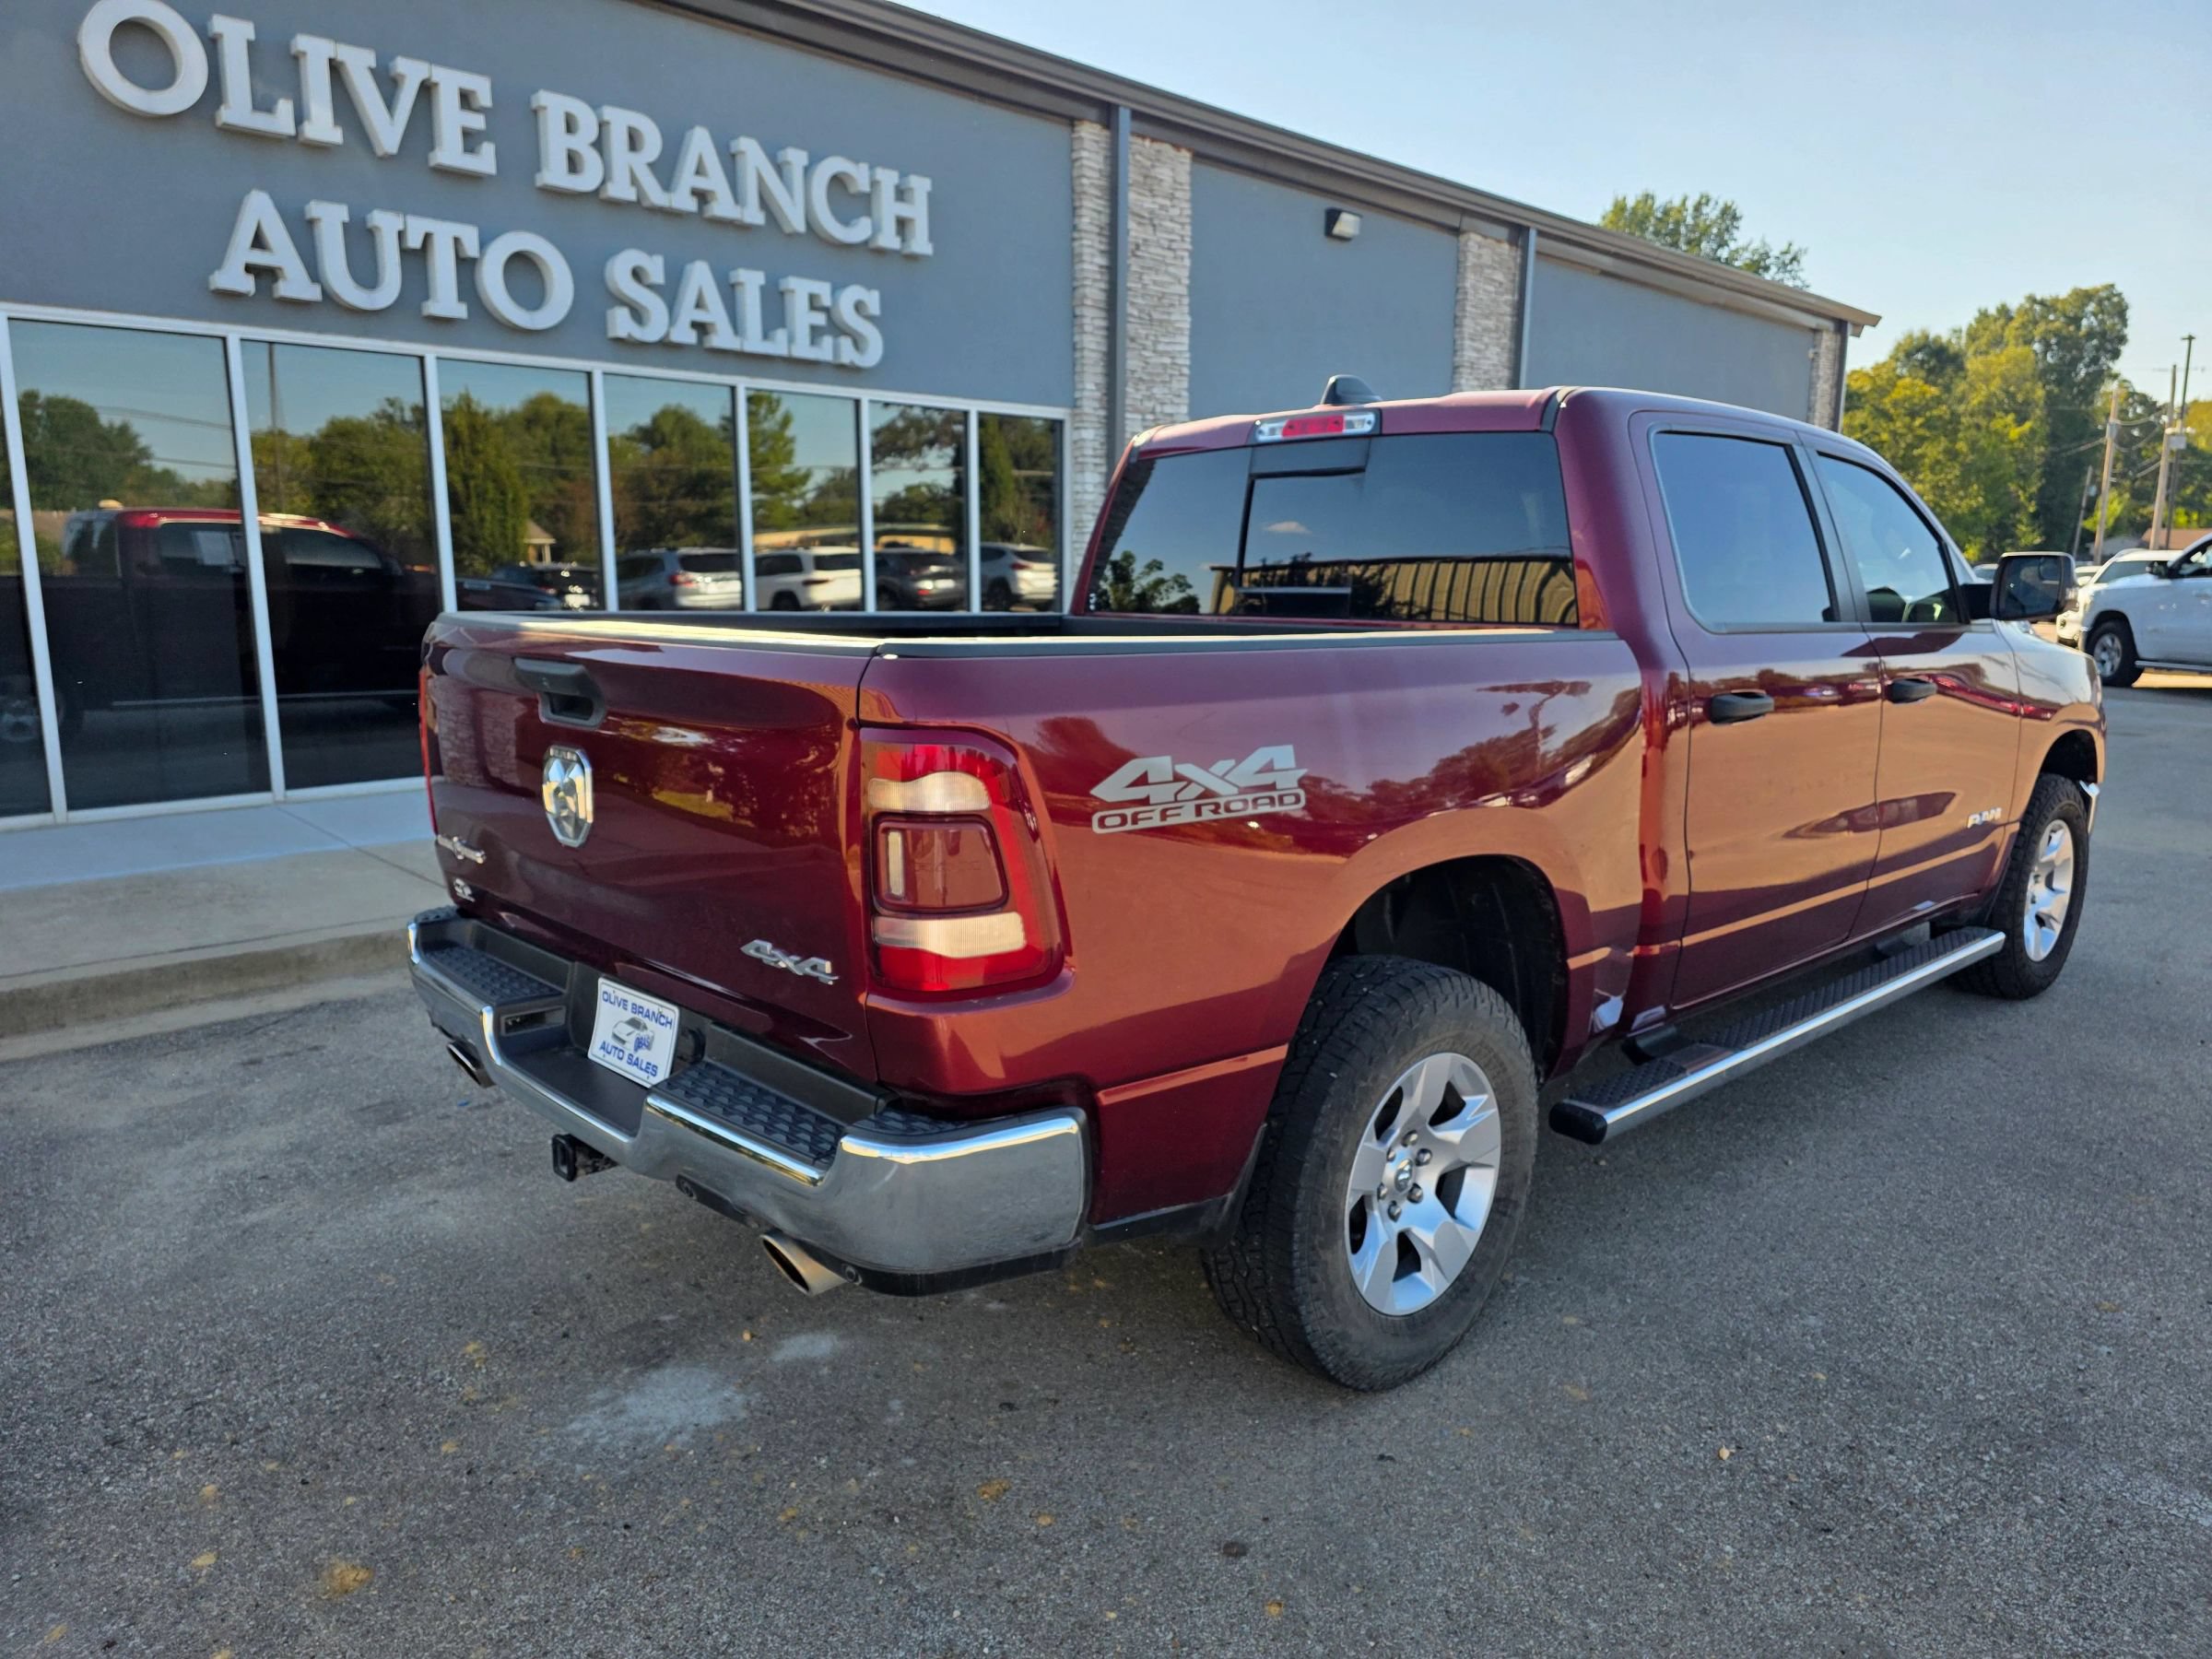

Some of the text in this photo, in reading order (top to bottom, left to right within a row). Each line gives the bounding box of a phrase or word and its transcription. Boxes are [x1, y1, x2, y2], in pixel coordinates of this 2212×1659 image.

[77, 0, 933, 257] OLIVE BRANCH
[208, 189, 884, 369] AUTO SALES
[1097, 790, 1301, 830] OFF ROAD
[602, 991, 673, 1030] OLIVE BRANCH
[599, 1041, 625, 1062] AUTO
[626, 1053, 658, 1078] SALES
